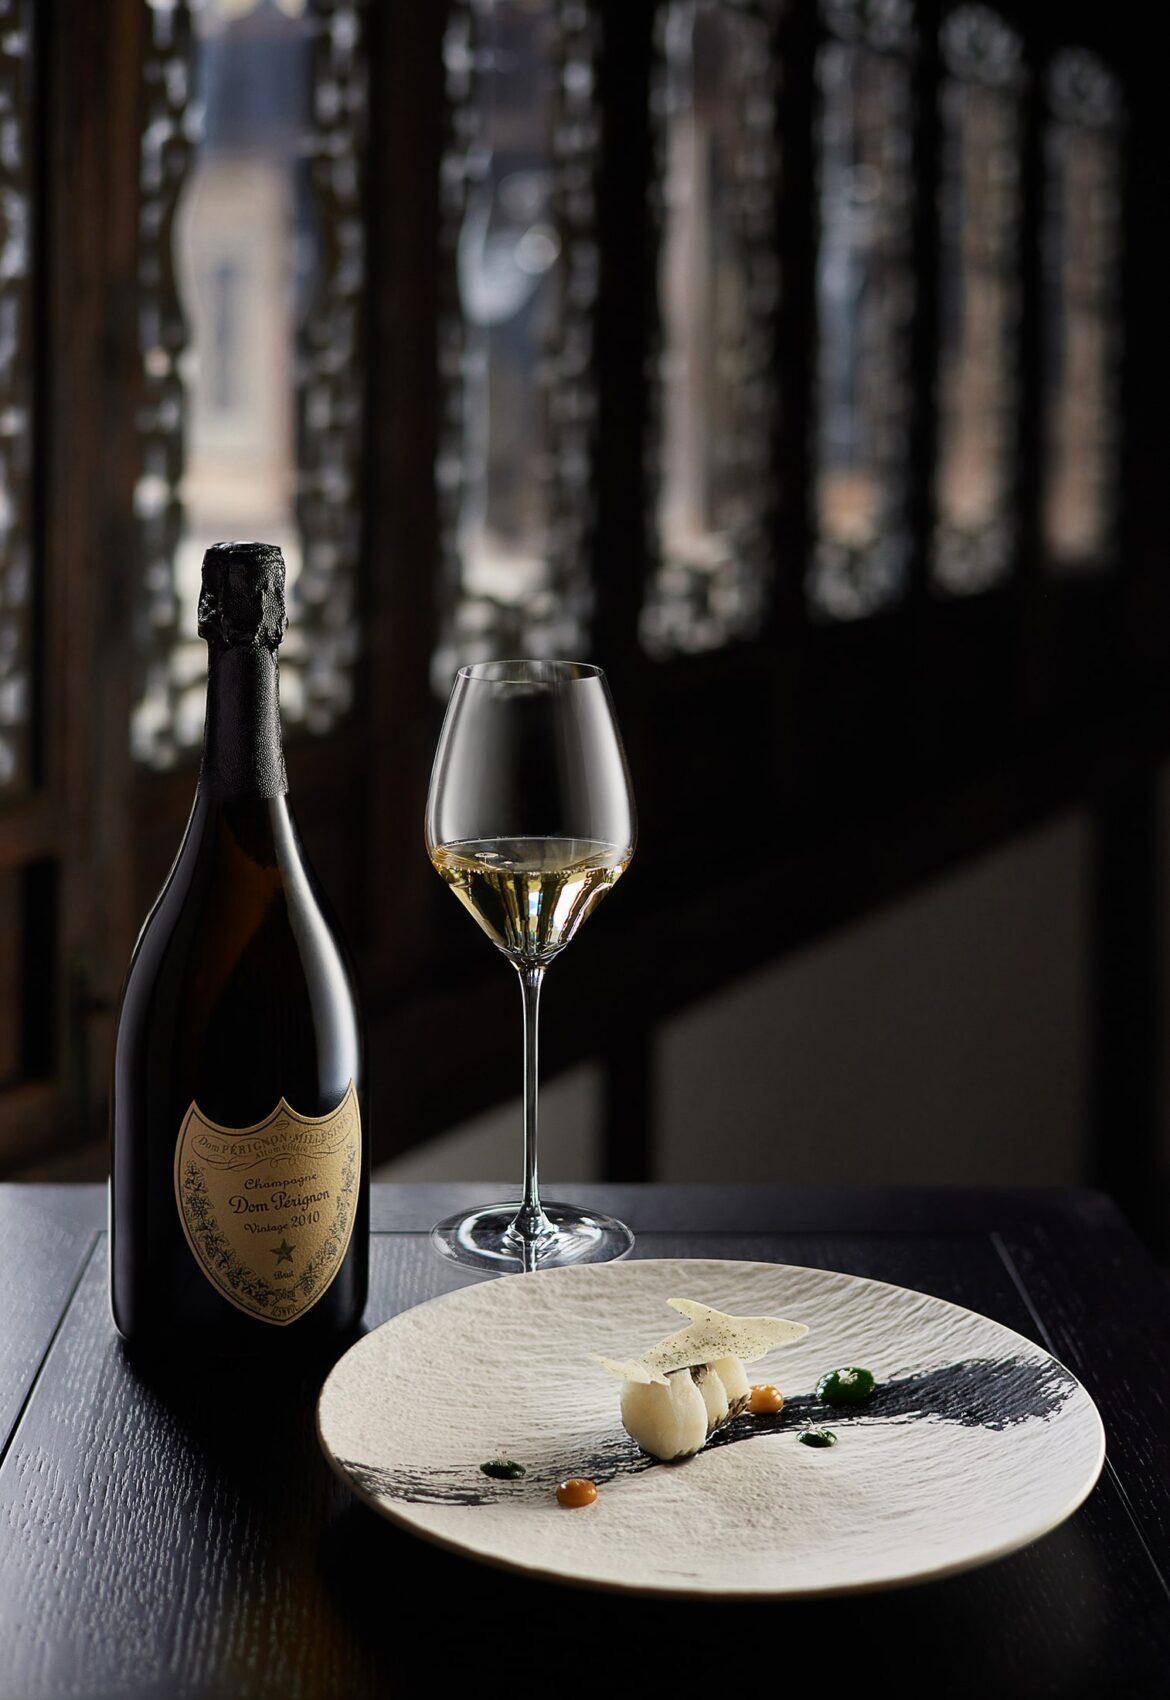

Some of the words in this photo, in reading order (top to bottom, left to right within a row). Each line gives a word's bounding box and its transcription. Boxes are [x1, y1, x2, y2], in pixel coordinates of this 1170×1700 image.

[199, 1136, 220, 1152] Dom
[244, 1174, 317, 1190] Champagne
[228, 1195, 270, 1214] Dom
[271, 1191, 330, 1211] Pérignon
[244, 1223, 288, 1234] Vintage
[291, 1211, 320, 1228] 2010
